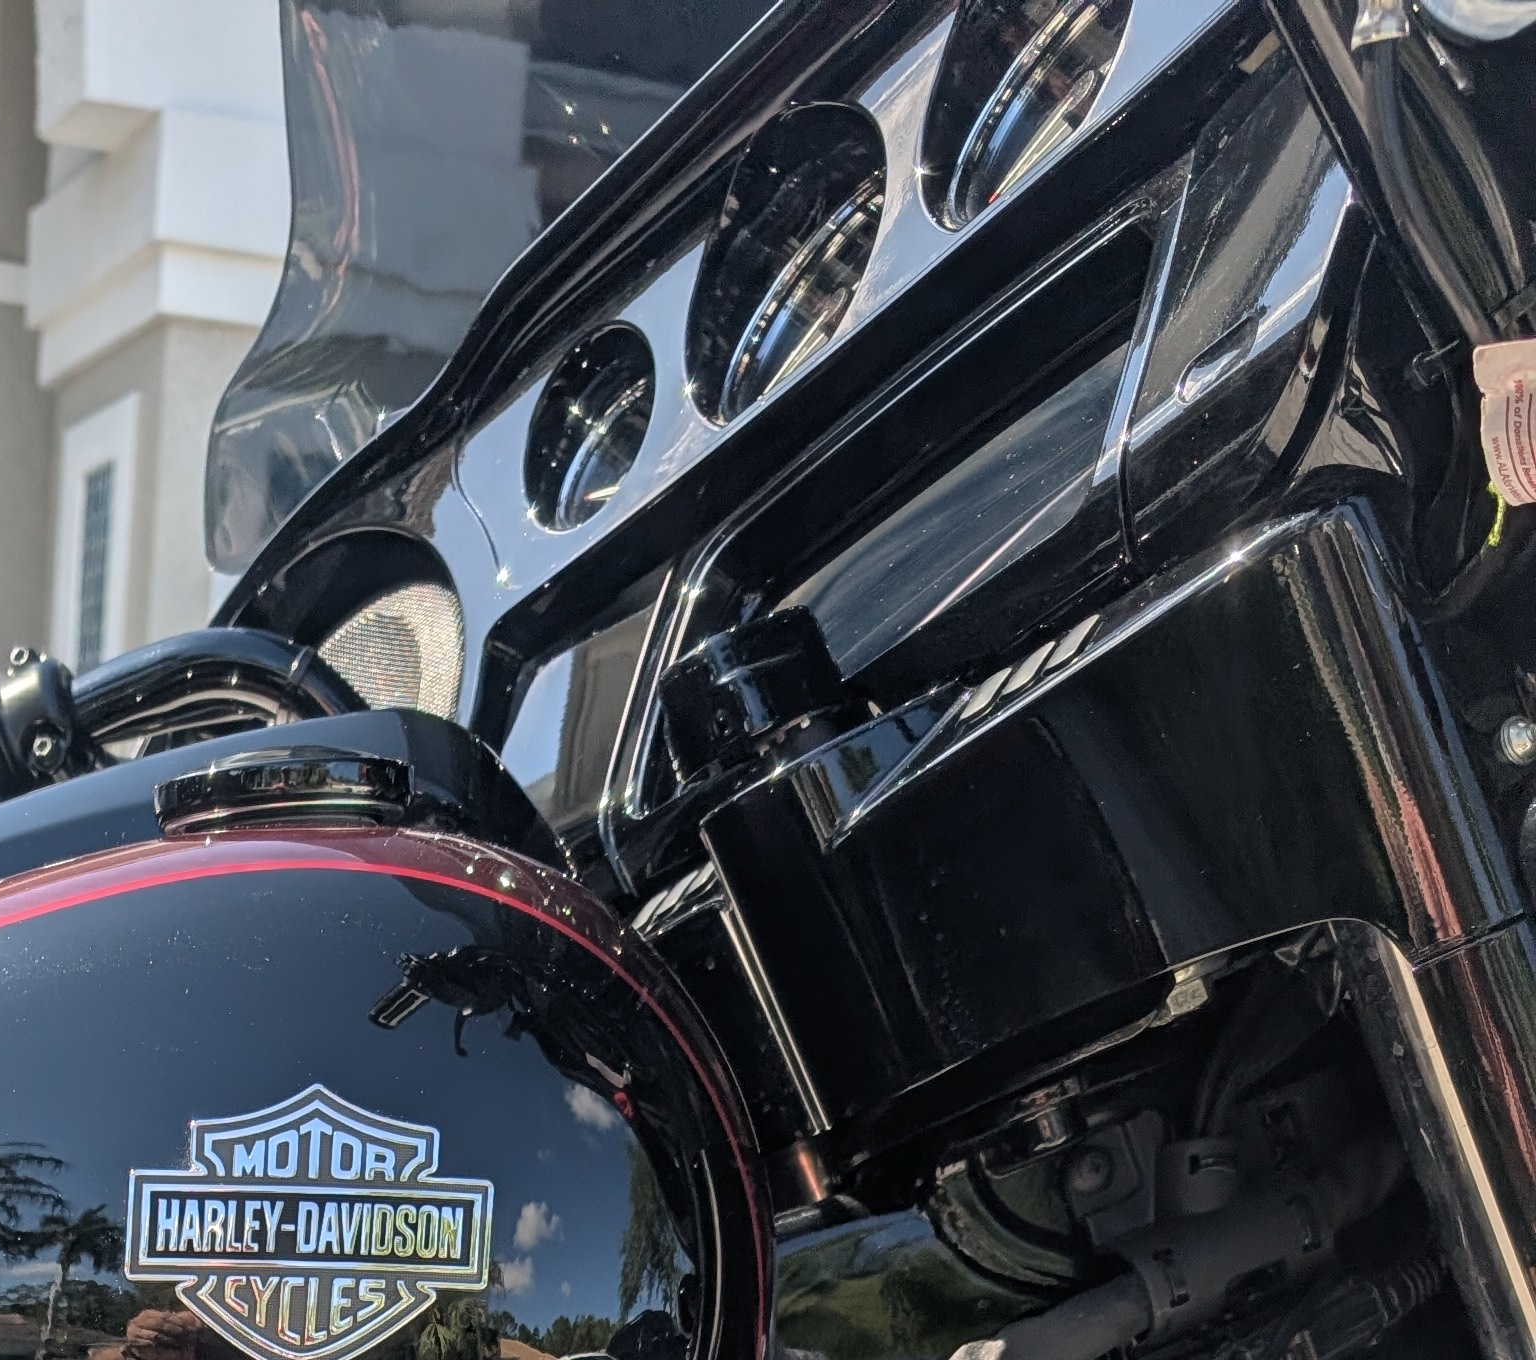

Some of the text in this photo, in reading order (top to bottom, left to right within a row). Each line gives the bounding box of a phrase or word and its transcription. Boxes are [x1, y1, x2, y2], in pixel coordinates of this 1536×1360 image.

[1513, 406, 1523, 419] of
[233, 1117, 396, 1181] MOTOR
[155, 1198, 464, 1260] HARLEY-DAVIDSON
[224, 1275, 387, 1345] CYCLES
